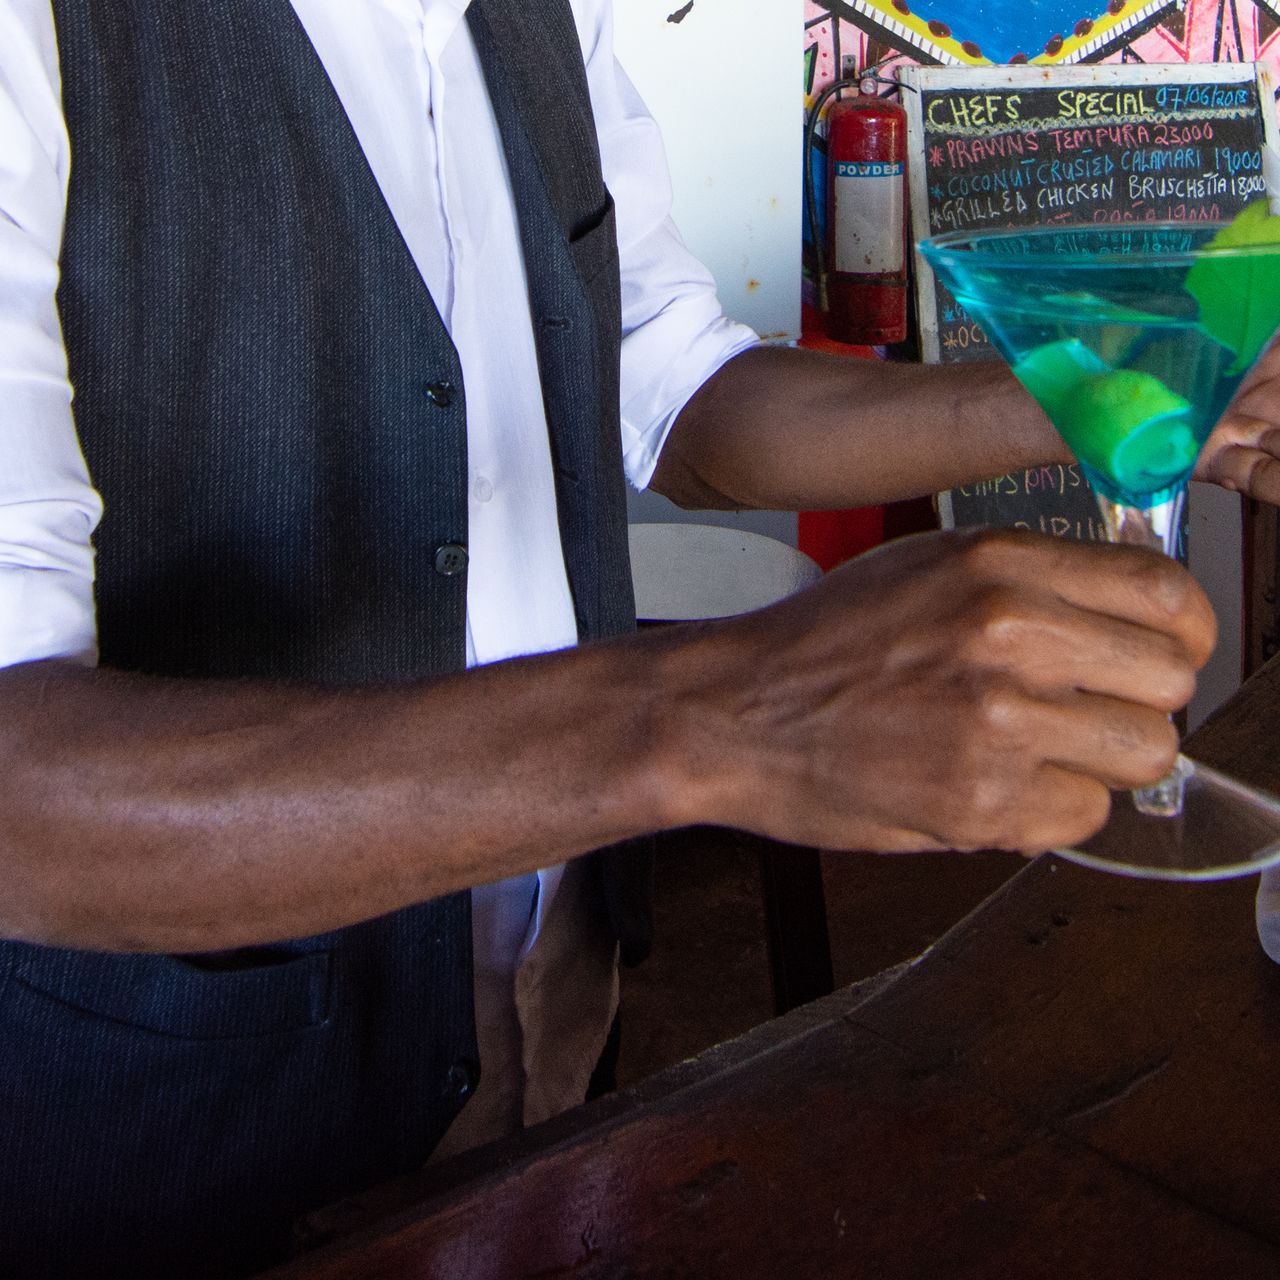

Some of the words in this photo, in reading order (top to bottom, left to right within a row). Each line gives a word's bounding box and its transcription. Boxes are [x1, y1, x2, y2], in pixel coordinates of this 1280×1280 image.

[927, 95, 1021, 128] CHEFS
[1057, 89, 1154, 118] SPECIAL
[946, 131, 1040, 169] PRAWNS
[1048, 124, 1150, 154] TEMPURA
[838, 163, 900, 176] POWDER
[947, 159, 1036, 197] COCONUT
[1121, 147, 1201, 171] CALAMARI
[942, 190, 1028, 230] GRILLED
[1036, 177, 1114, 210] CHICKEN
